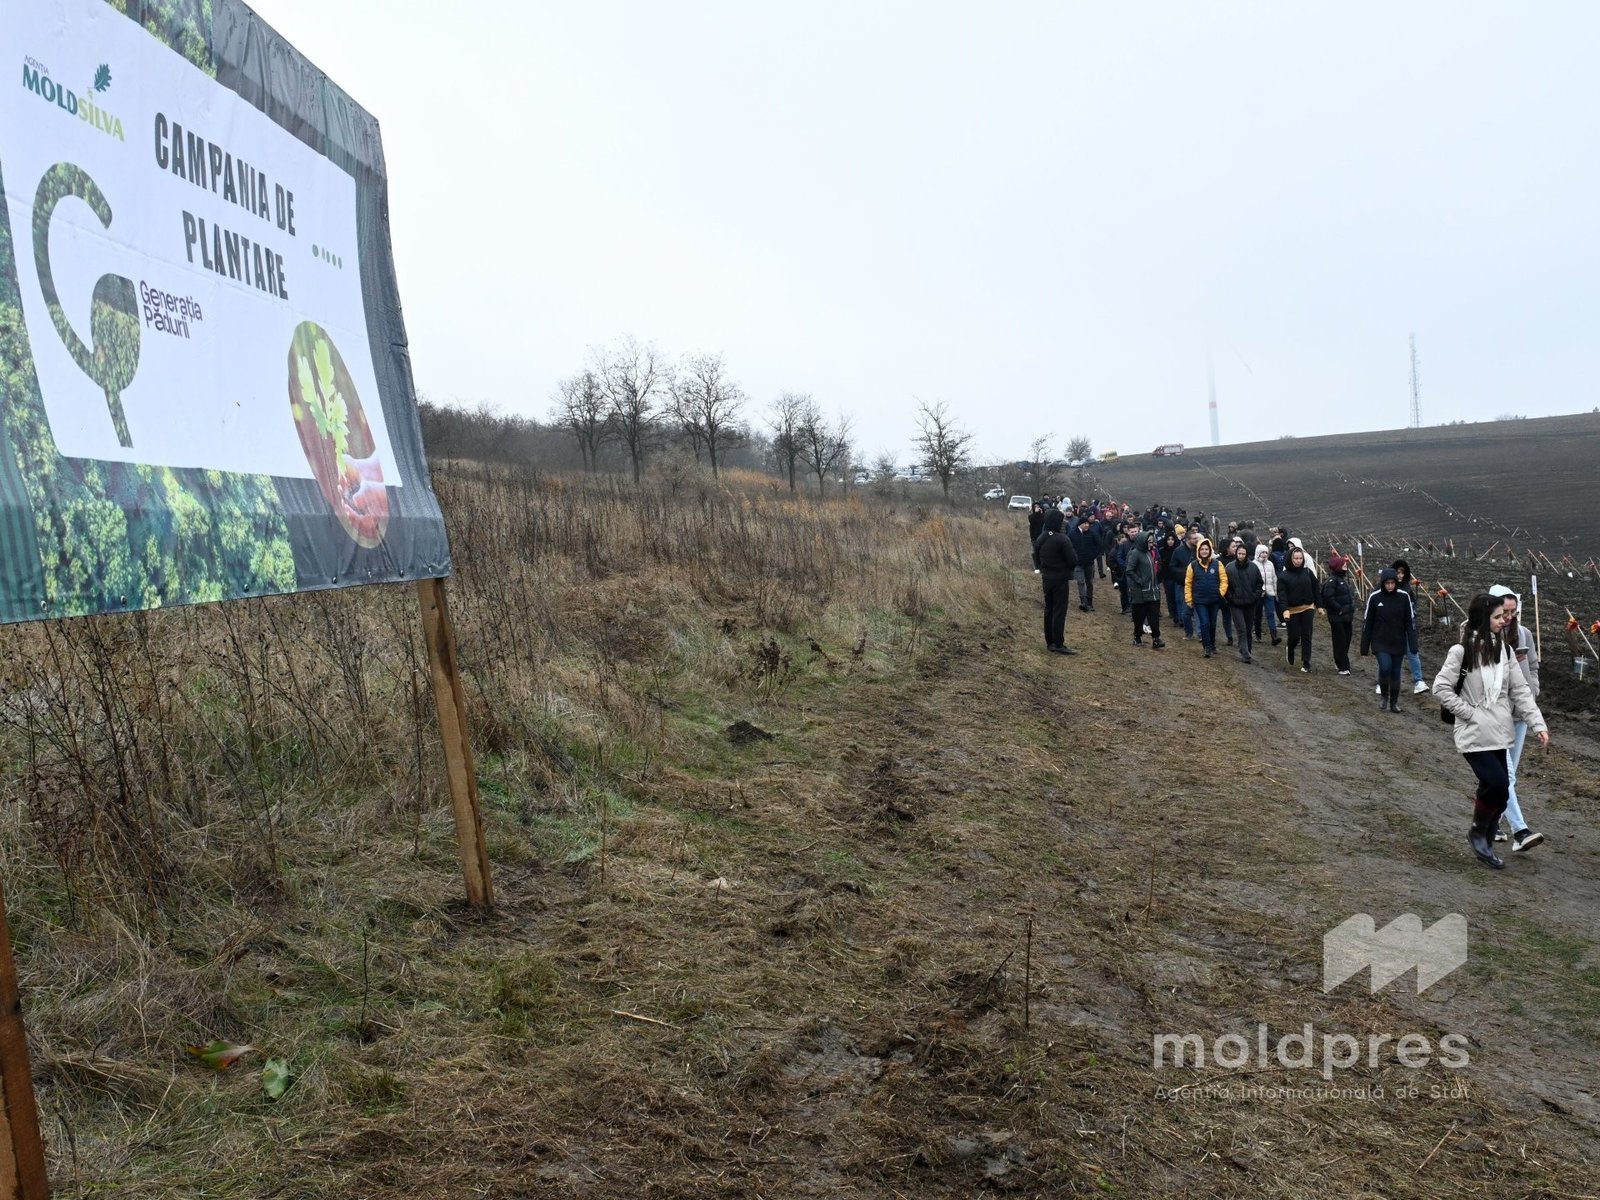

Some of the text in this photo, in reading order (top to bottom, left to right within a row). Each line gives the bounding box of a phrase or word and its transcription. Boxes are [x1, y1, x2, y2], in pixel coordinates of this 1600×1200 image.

[154, 112, 296, 237] CAMPANIA DE
[182, 210, 288, 300] PLANTARE
